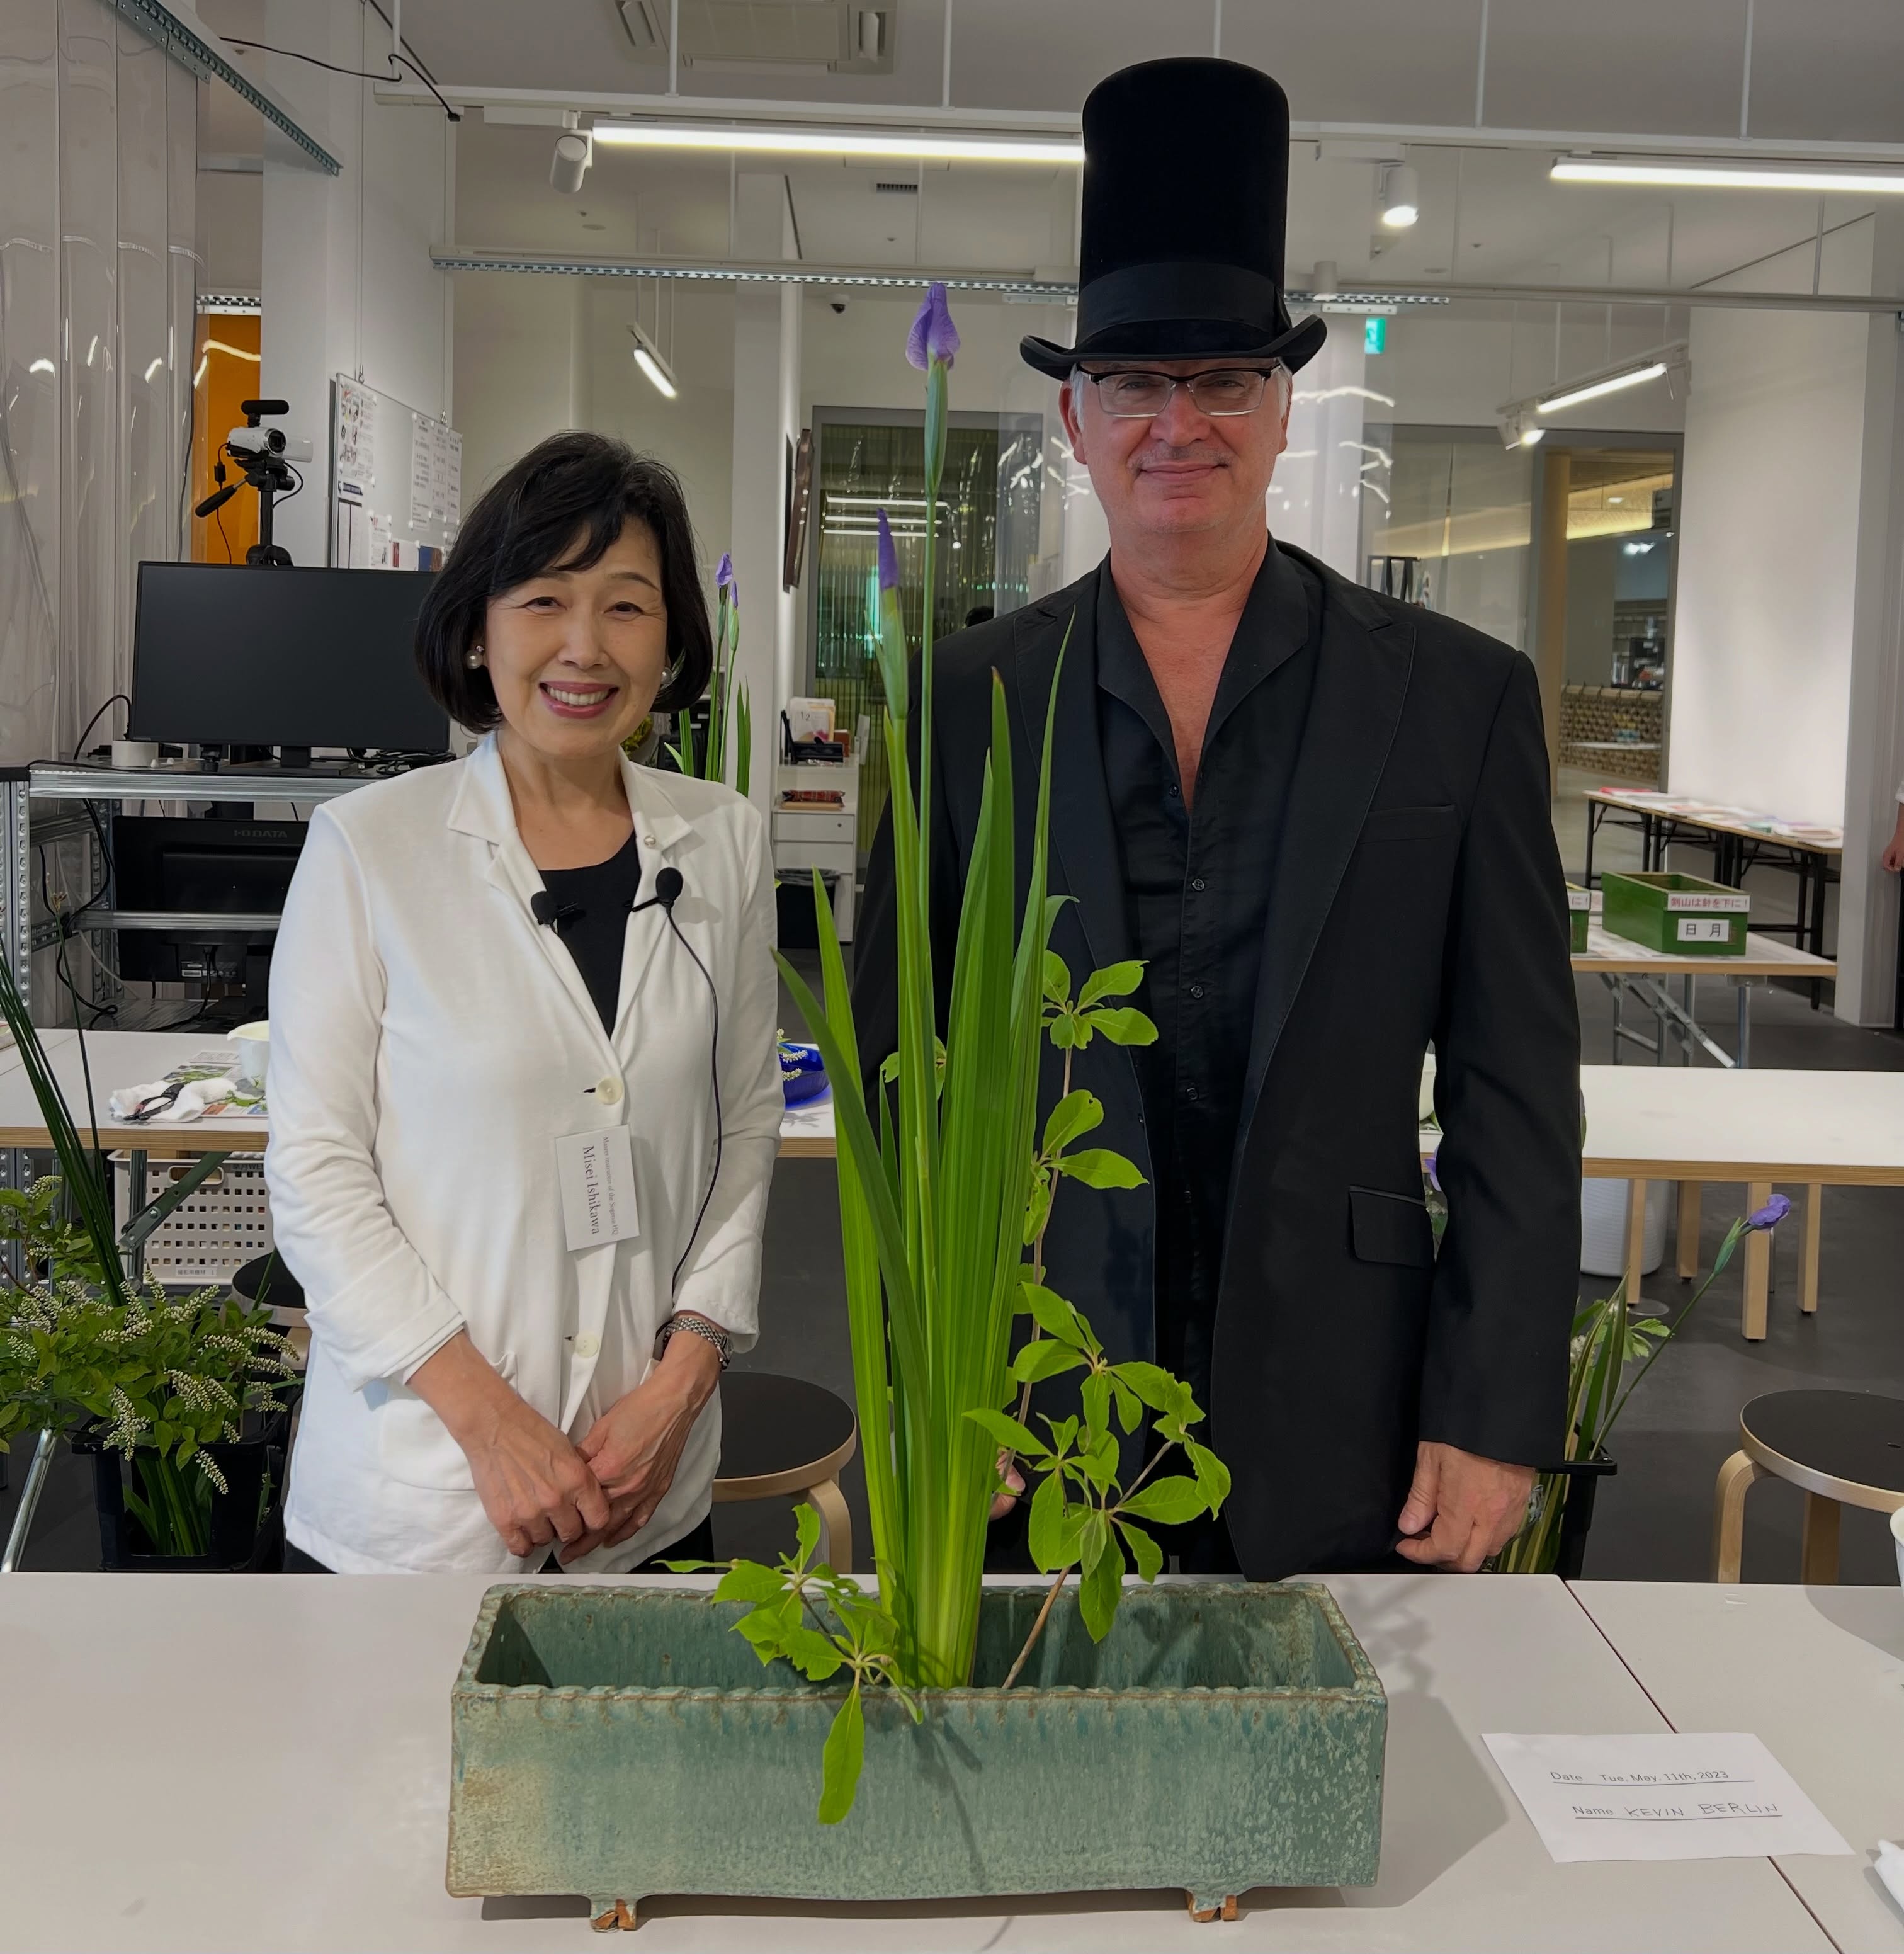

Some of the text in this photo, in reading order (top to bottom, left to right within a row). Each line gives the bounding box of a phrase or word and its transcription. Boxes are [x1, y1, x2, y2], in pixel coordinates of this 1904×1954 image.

[582, 1145, 601, 1235] Misei Ishikawa
[1550, 1771, 1583, 1781] Date
[1697, 1771, 1728, 1780] 2023
[1572, 1802, 1777, 1817] Name KEVIN BERLIN
